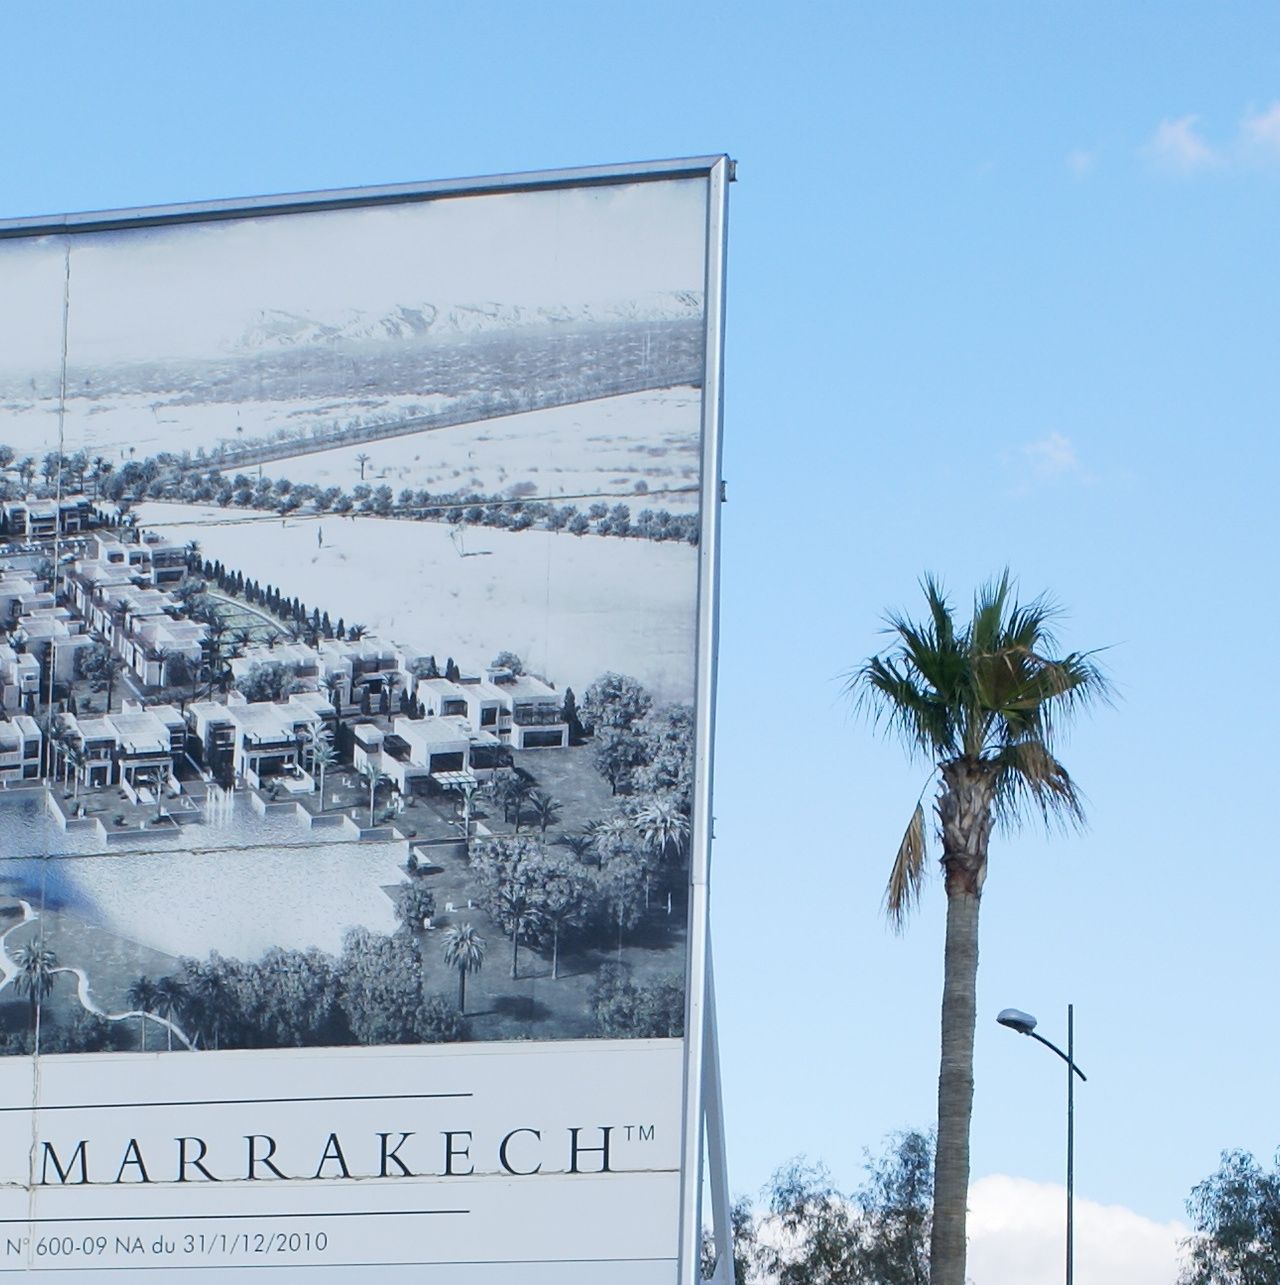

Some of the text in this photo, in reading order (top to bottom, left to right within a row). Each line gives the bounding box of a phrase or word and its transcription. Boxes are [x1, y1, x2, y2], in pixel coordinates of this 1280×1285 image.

[38, 1125, 616, 1186] MARRAKECH
[36, 1236, 108, 1256] 600-09
[115, 1235, 146, 1255] NA
[152, 1234, 176, 1254] du
[183, 1231, 329, 1255] 31/1/12/2010
